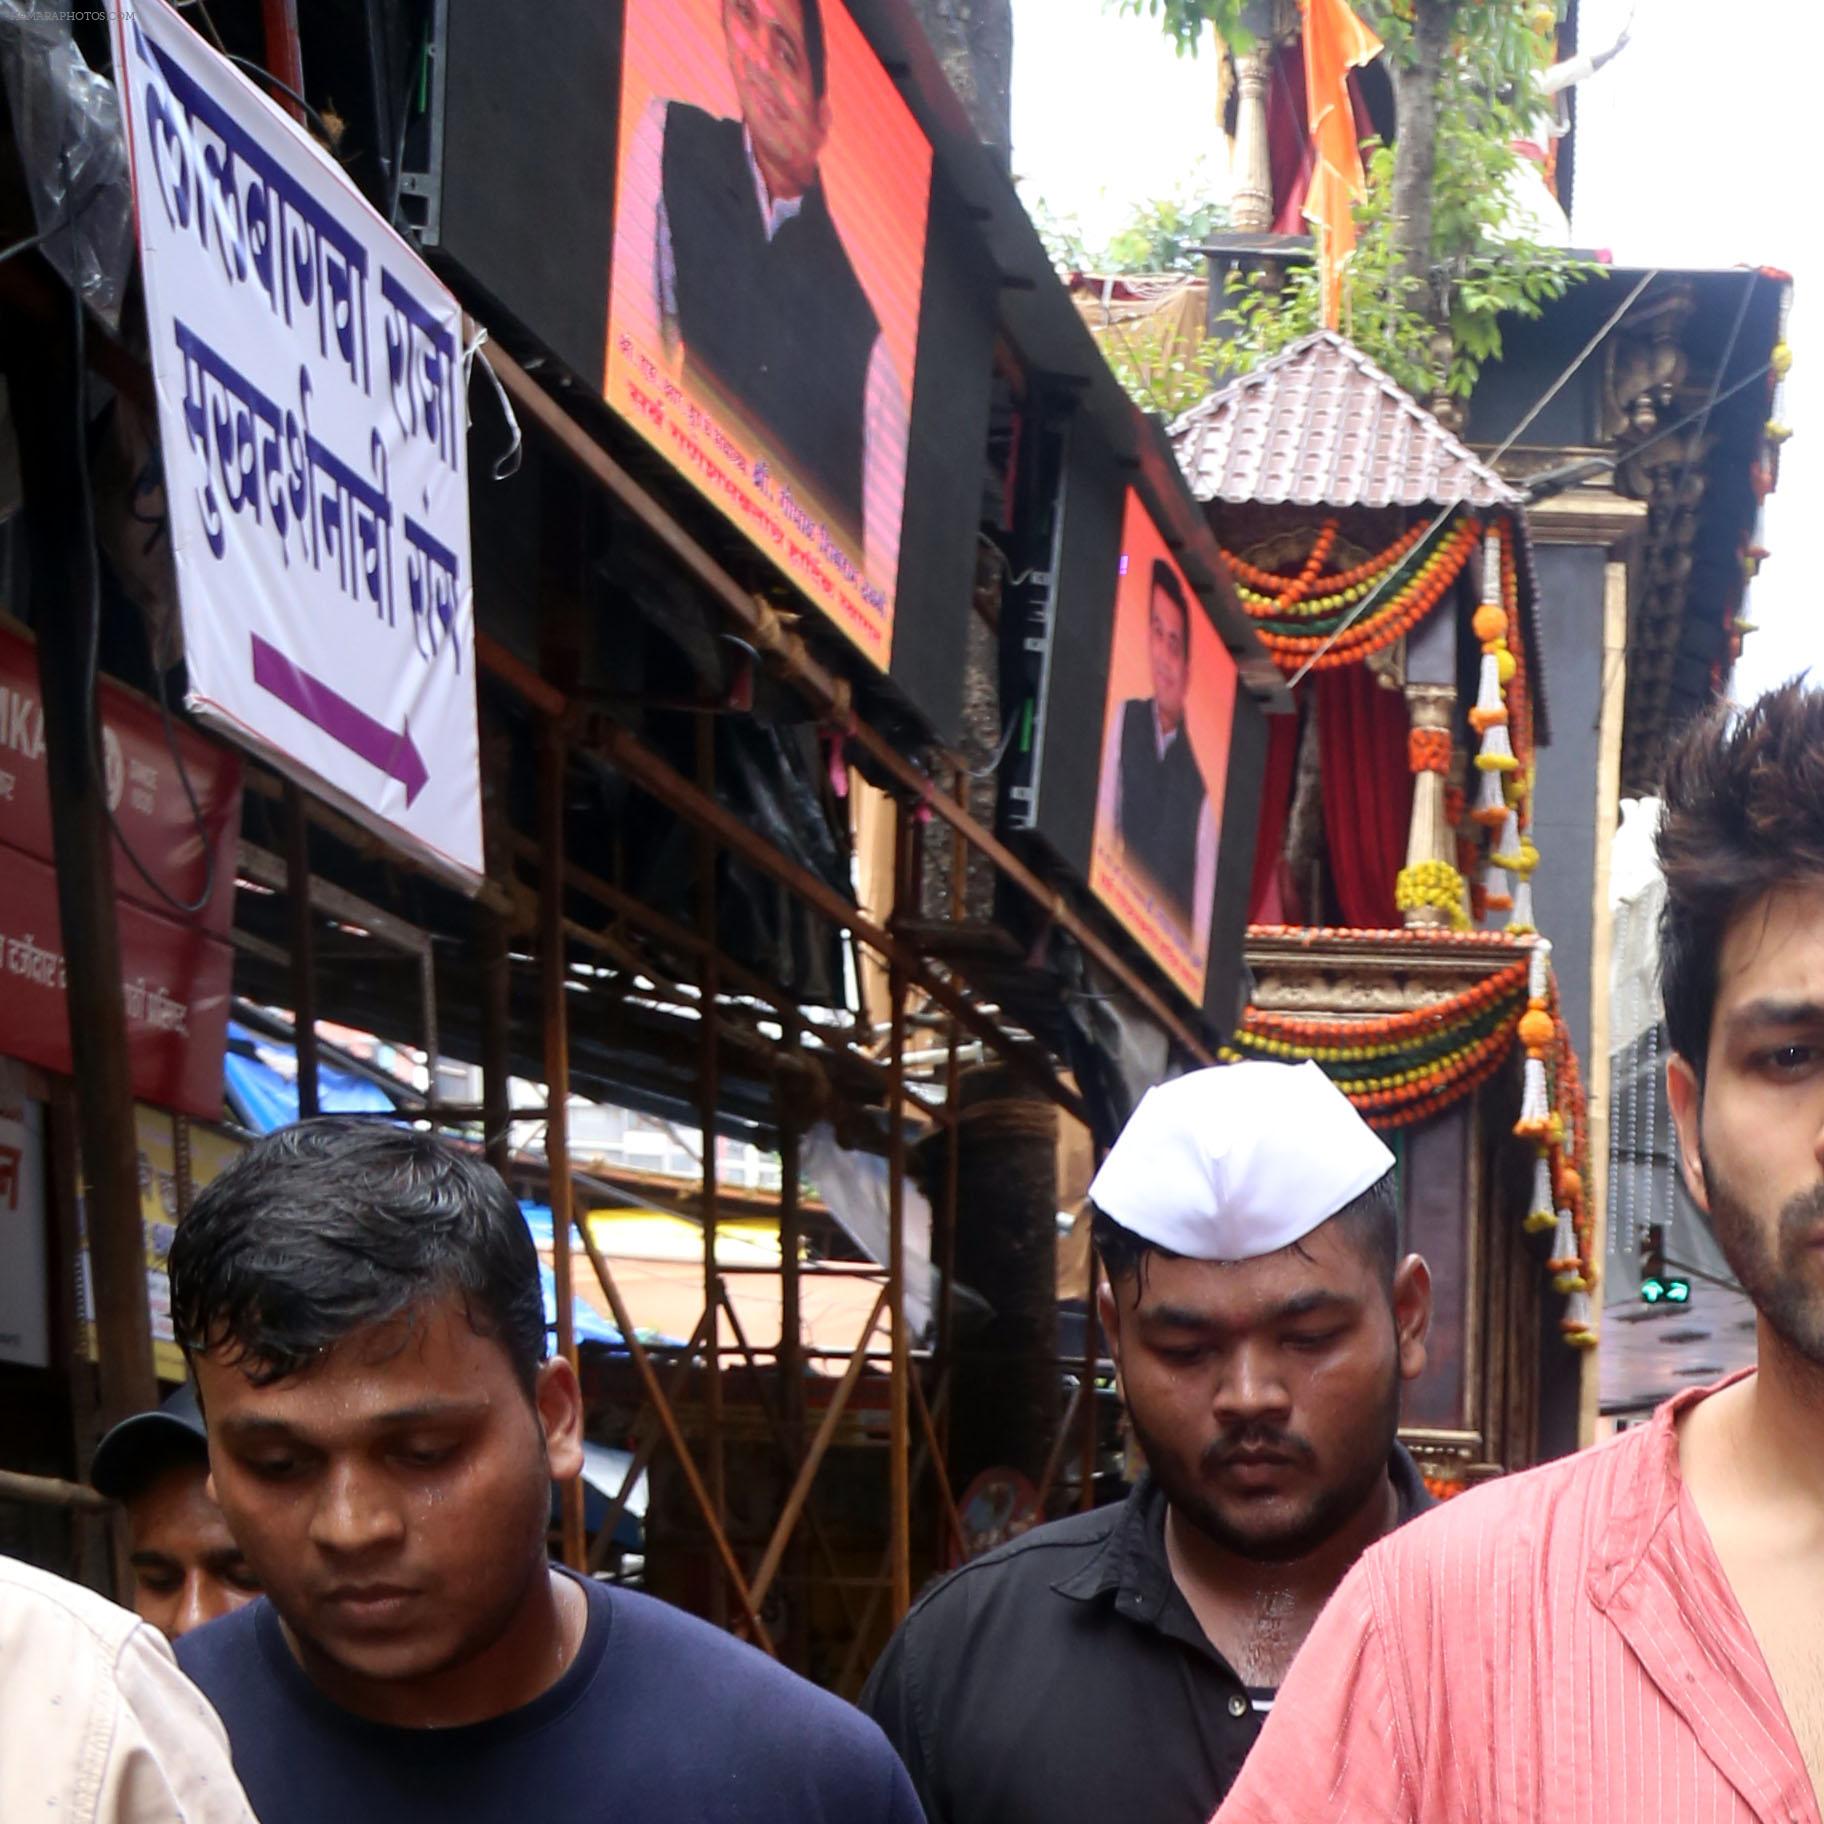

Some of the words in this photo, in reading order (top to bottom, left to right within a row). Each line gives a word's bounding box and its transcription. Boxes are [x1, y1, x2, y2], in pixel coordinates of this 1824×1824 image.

[134, 18, 371, 396] लालबागचा
[381, 264, 457, 472] राजा
[173, 316, 395, 628] मुखदर्शनाची
[404, 484, 461, 675] रांग
